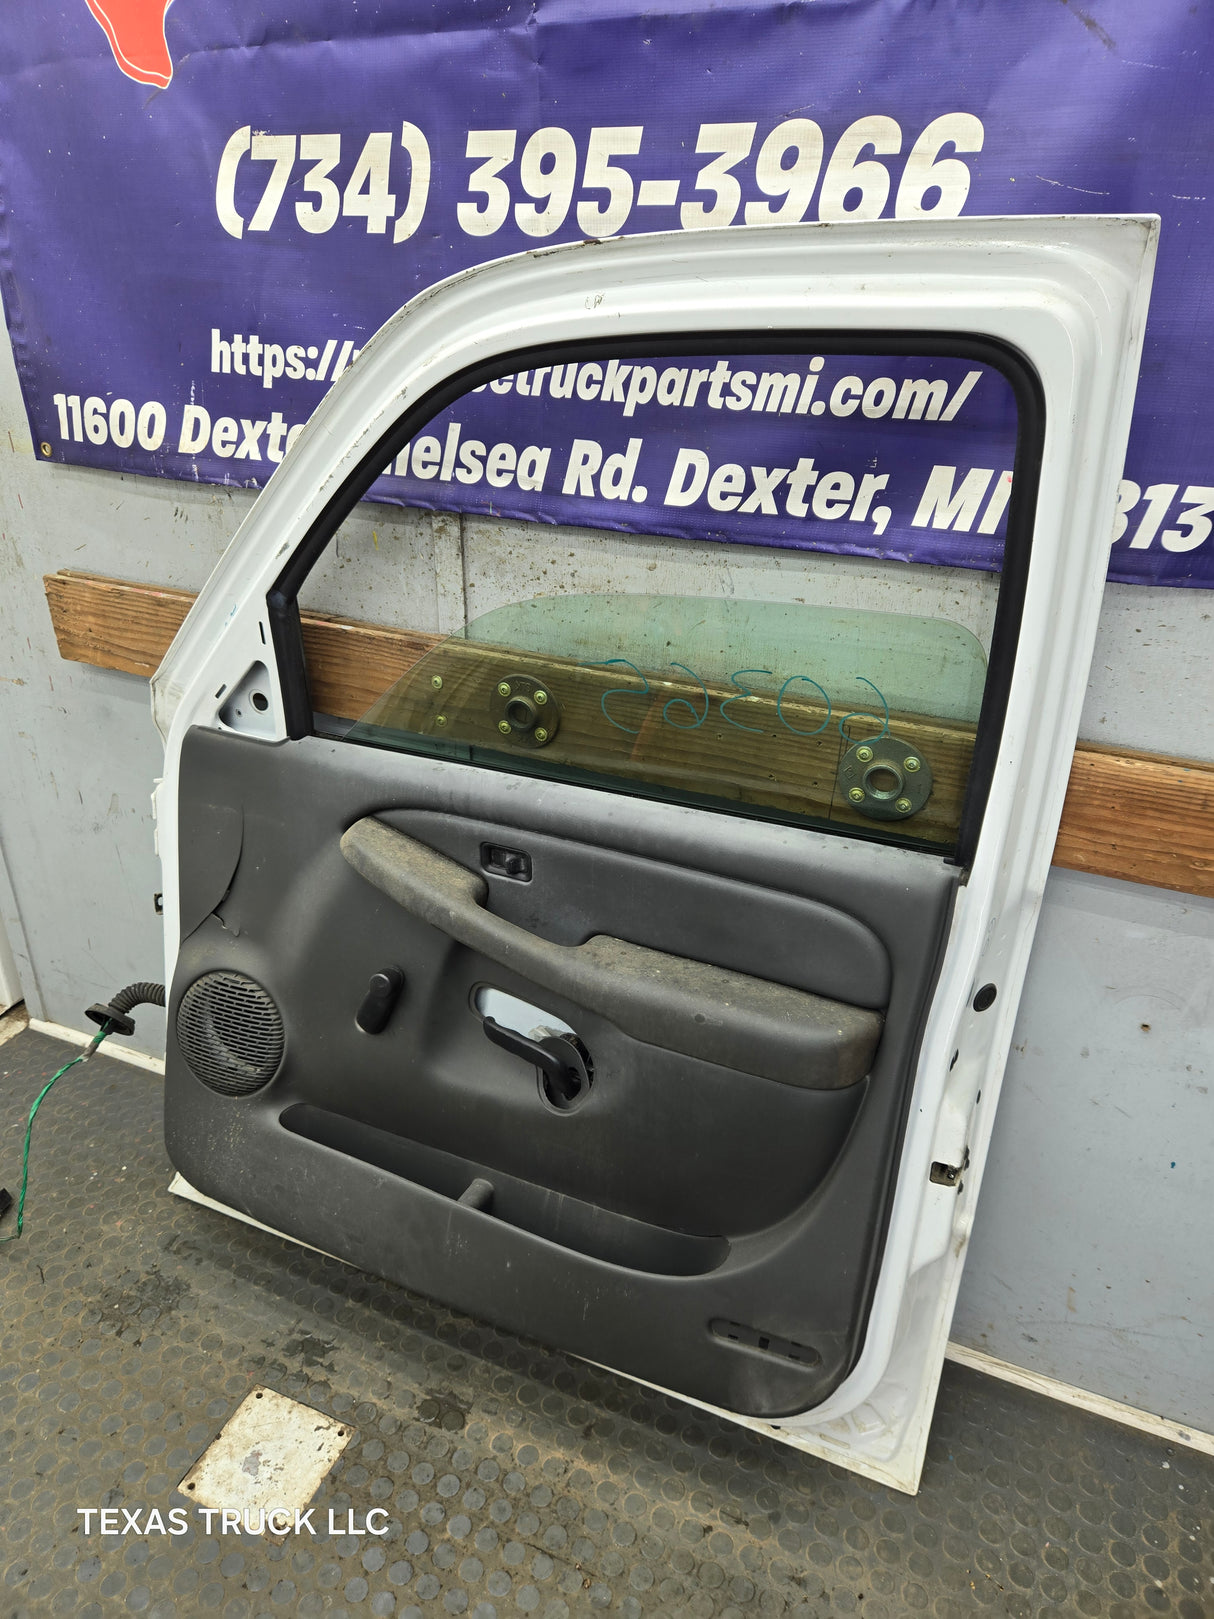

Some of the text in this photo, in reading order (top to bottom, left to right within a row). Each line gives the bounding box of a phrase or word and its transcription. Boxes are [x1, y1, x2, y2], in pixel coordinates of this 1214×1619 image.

[215, 112, 985, 244] (734) 395-3966
[53, 393, 1214, 553] 11600 Dext elsea Rd. Dexter, MI 813
